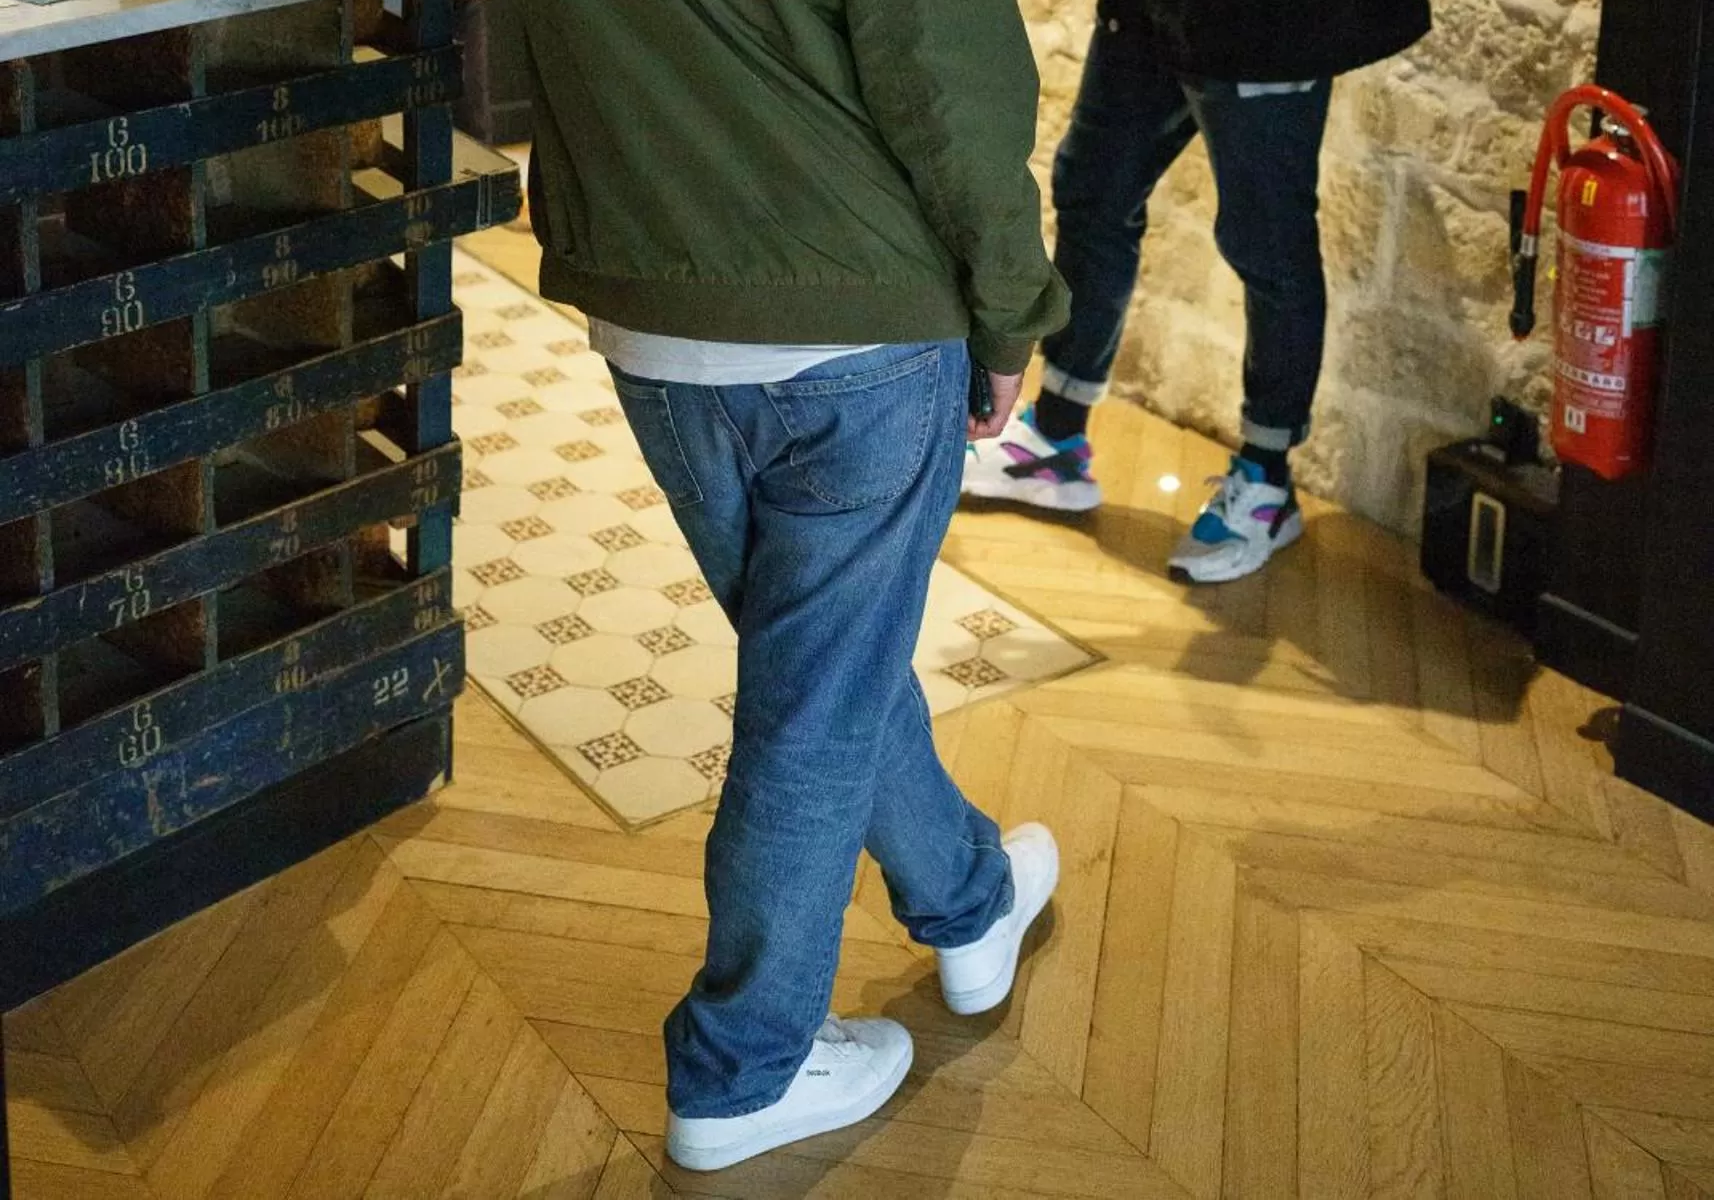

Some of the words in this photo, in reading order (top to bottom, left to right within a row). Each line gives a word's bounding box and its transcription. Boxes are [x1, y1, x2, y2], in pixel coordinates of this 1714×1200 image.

[90, 143, 147, 184] 100
[101, 299, 143, 337] 90
[107, 589, 151, 629] 70
[373, 666, 410, 707] 22
